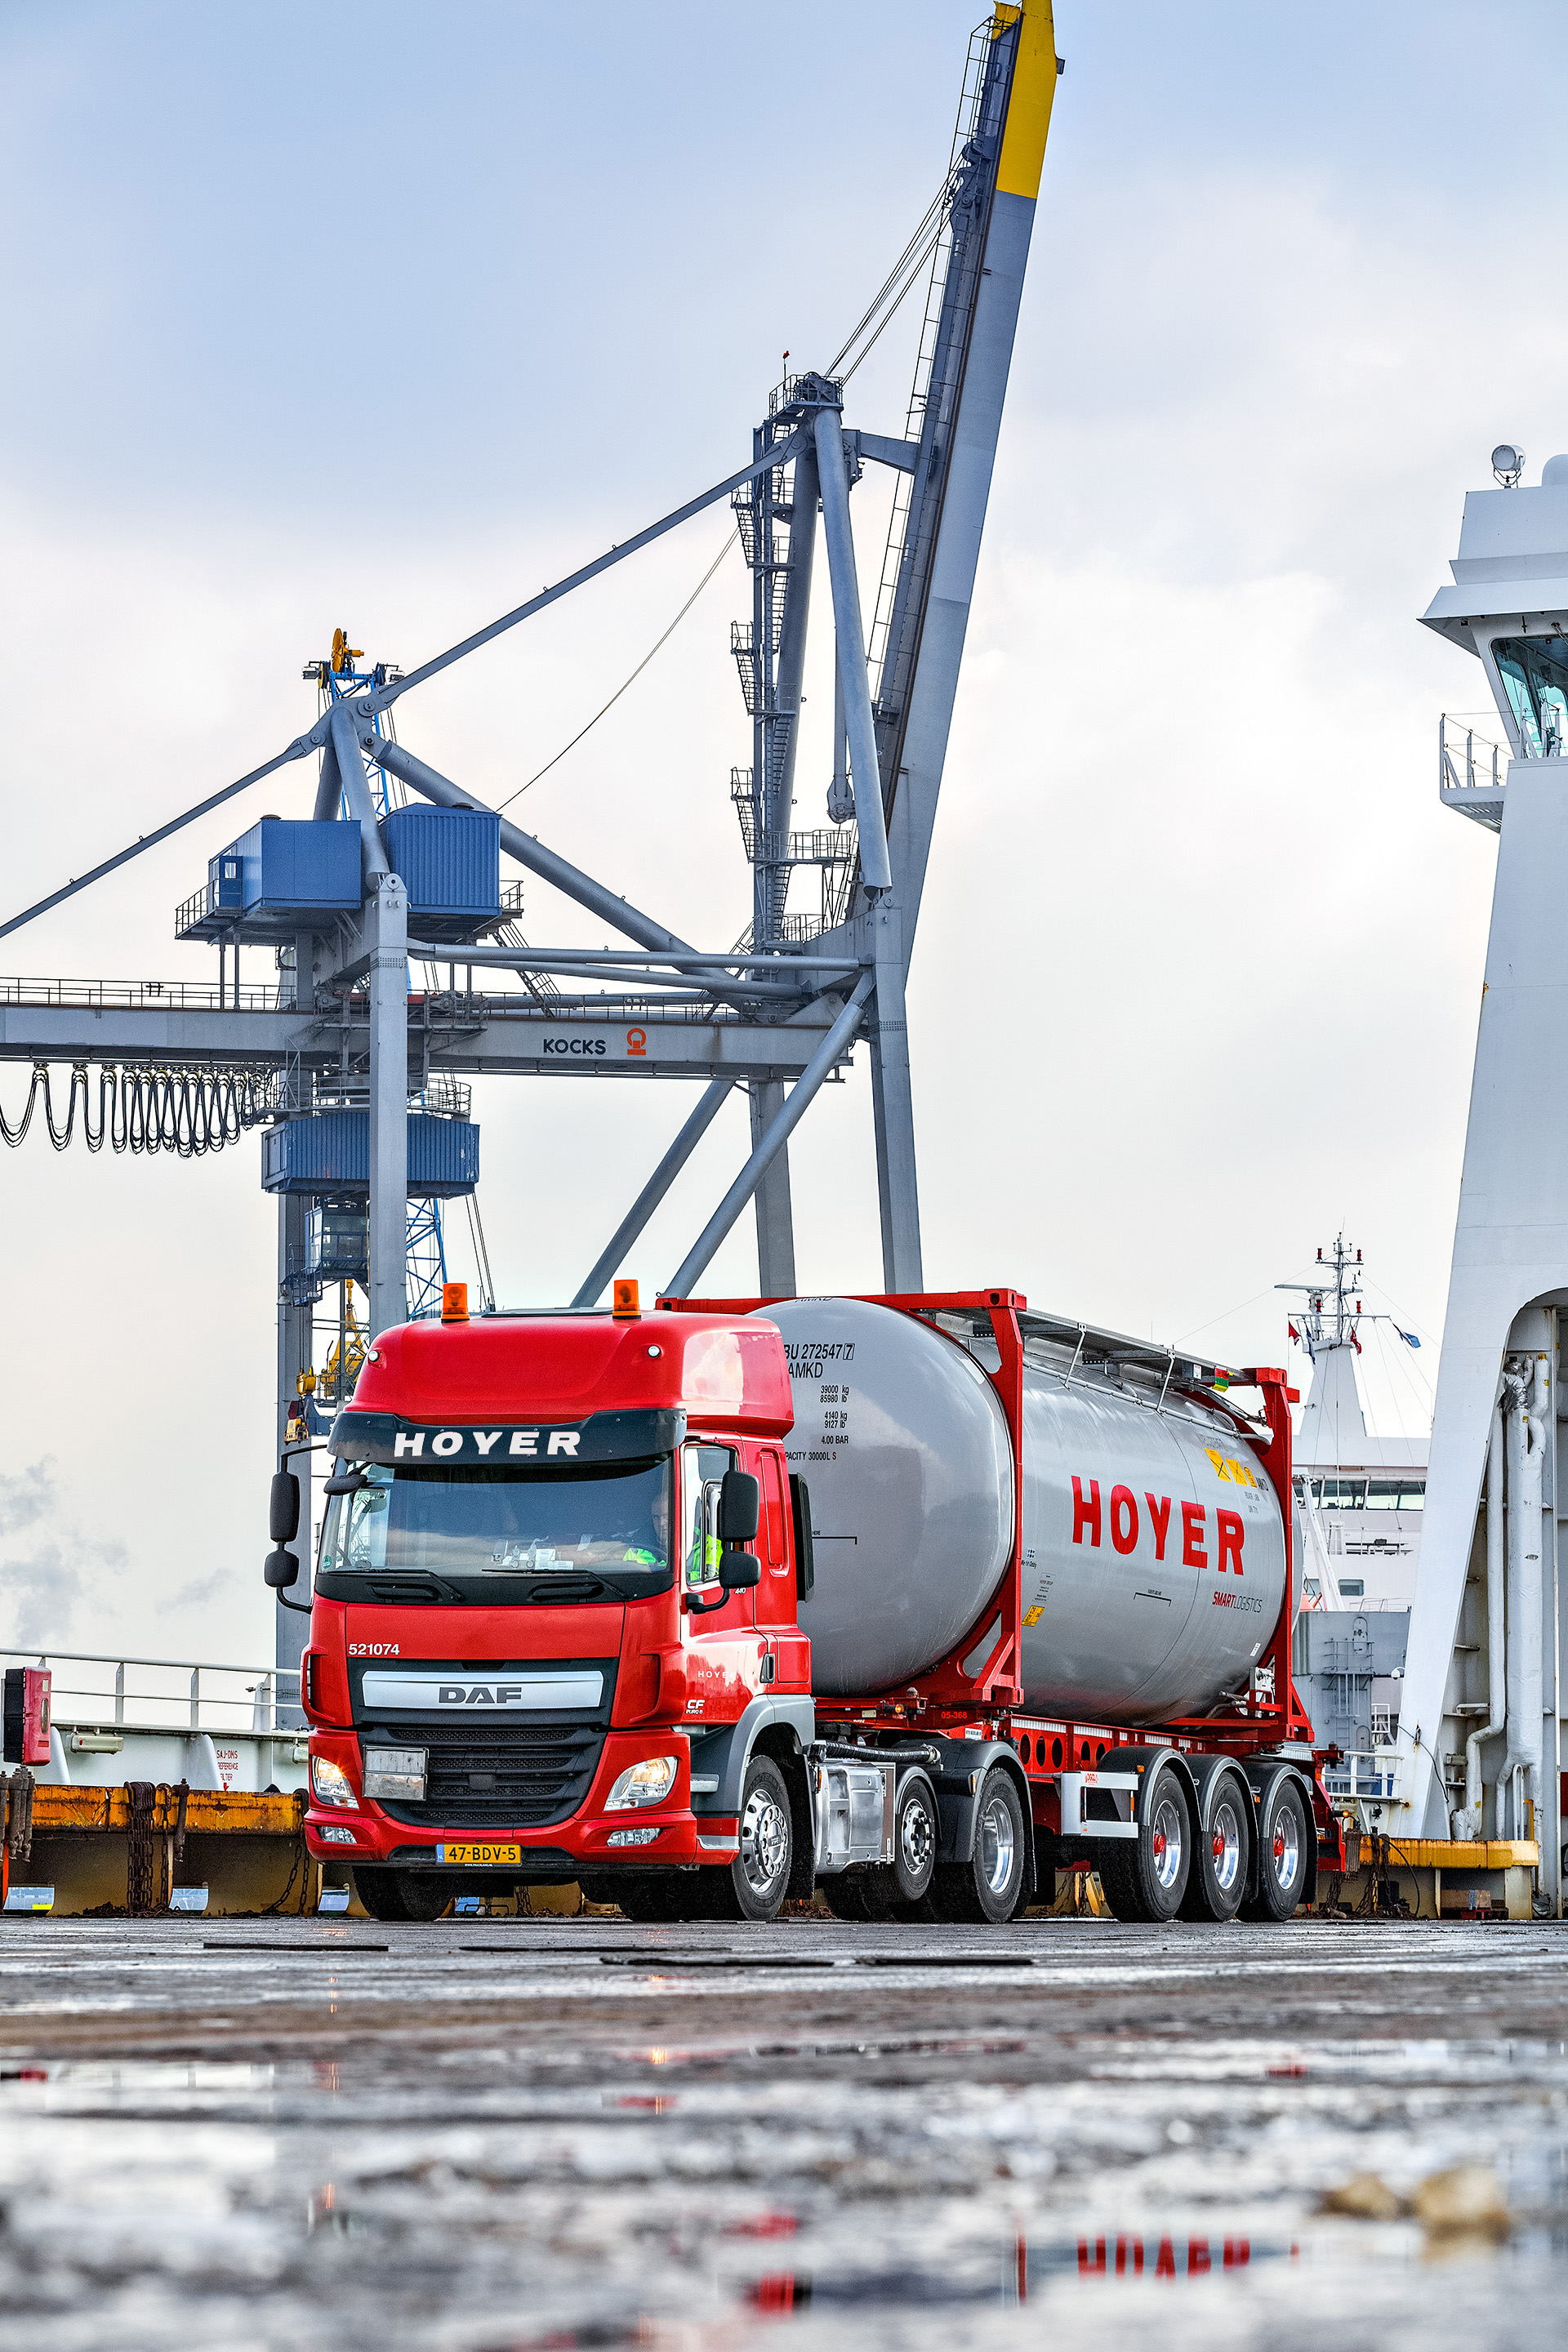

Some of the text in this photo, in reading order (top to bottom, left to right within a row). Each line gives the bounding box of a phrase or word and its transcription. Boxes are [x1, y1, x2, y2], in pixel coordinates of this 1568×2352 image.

[543, 1038, 606, 1055] KOCKS
[821, 1385, 849, 1396] 39000 kg
[820, 1394, 847, 1403] 85980 lb
[825, 1411, 848, 1421] 4140 kg
[825, 1420, 838, 1428] 9127
[394, 1432, 581, 1457] HOYER
[822, 1436, 849, 1444] 4.00 BAR
[832, 1452, 836, 1460] S
[1071, 1475, 1244, 1575] HOYER
[348, 1643, 400, 1655] 521074
[439, 1686, 522, 1704] DAF
[687, 1699, 705, 1709] CF
[941, 1711, 968, 1719] 05-368
[448, 1846, 516, 1860] 47-BDV-5
